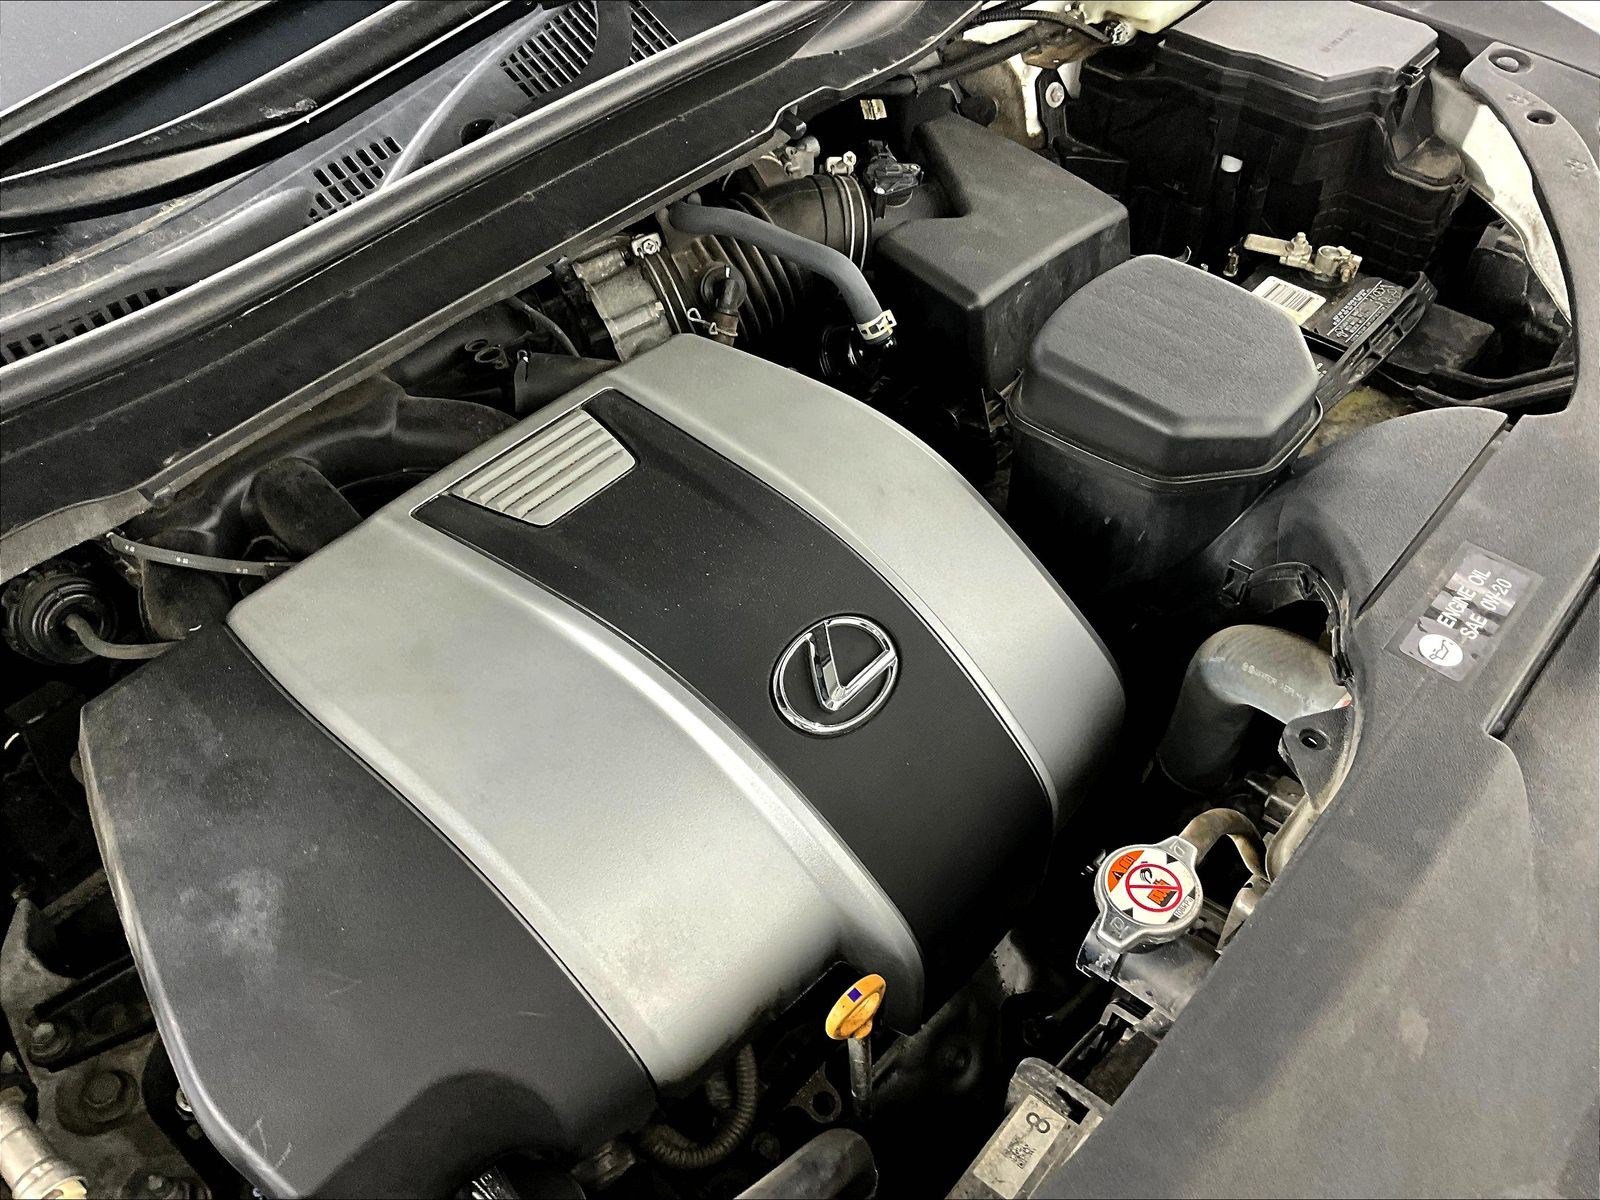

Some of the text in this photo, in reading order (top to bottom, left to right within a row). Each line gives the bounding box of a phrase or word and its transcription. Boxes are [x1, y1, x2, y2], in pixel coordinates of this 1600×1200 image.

[1437, 569, 1491, 629] ENGINE OIL
[1460, 578, 1513, 640] SAE 0W-20
[1026, 1112, 1051, 1134] 8
